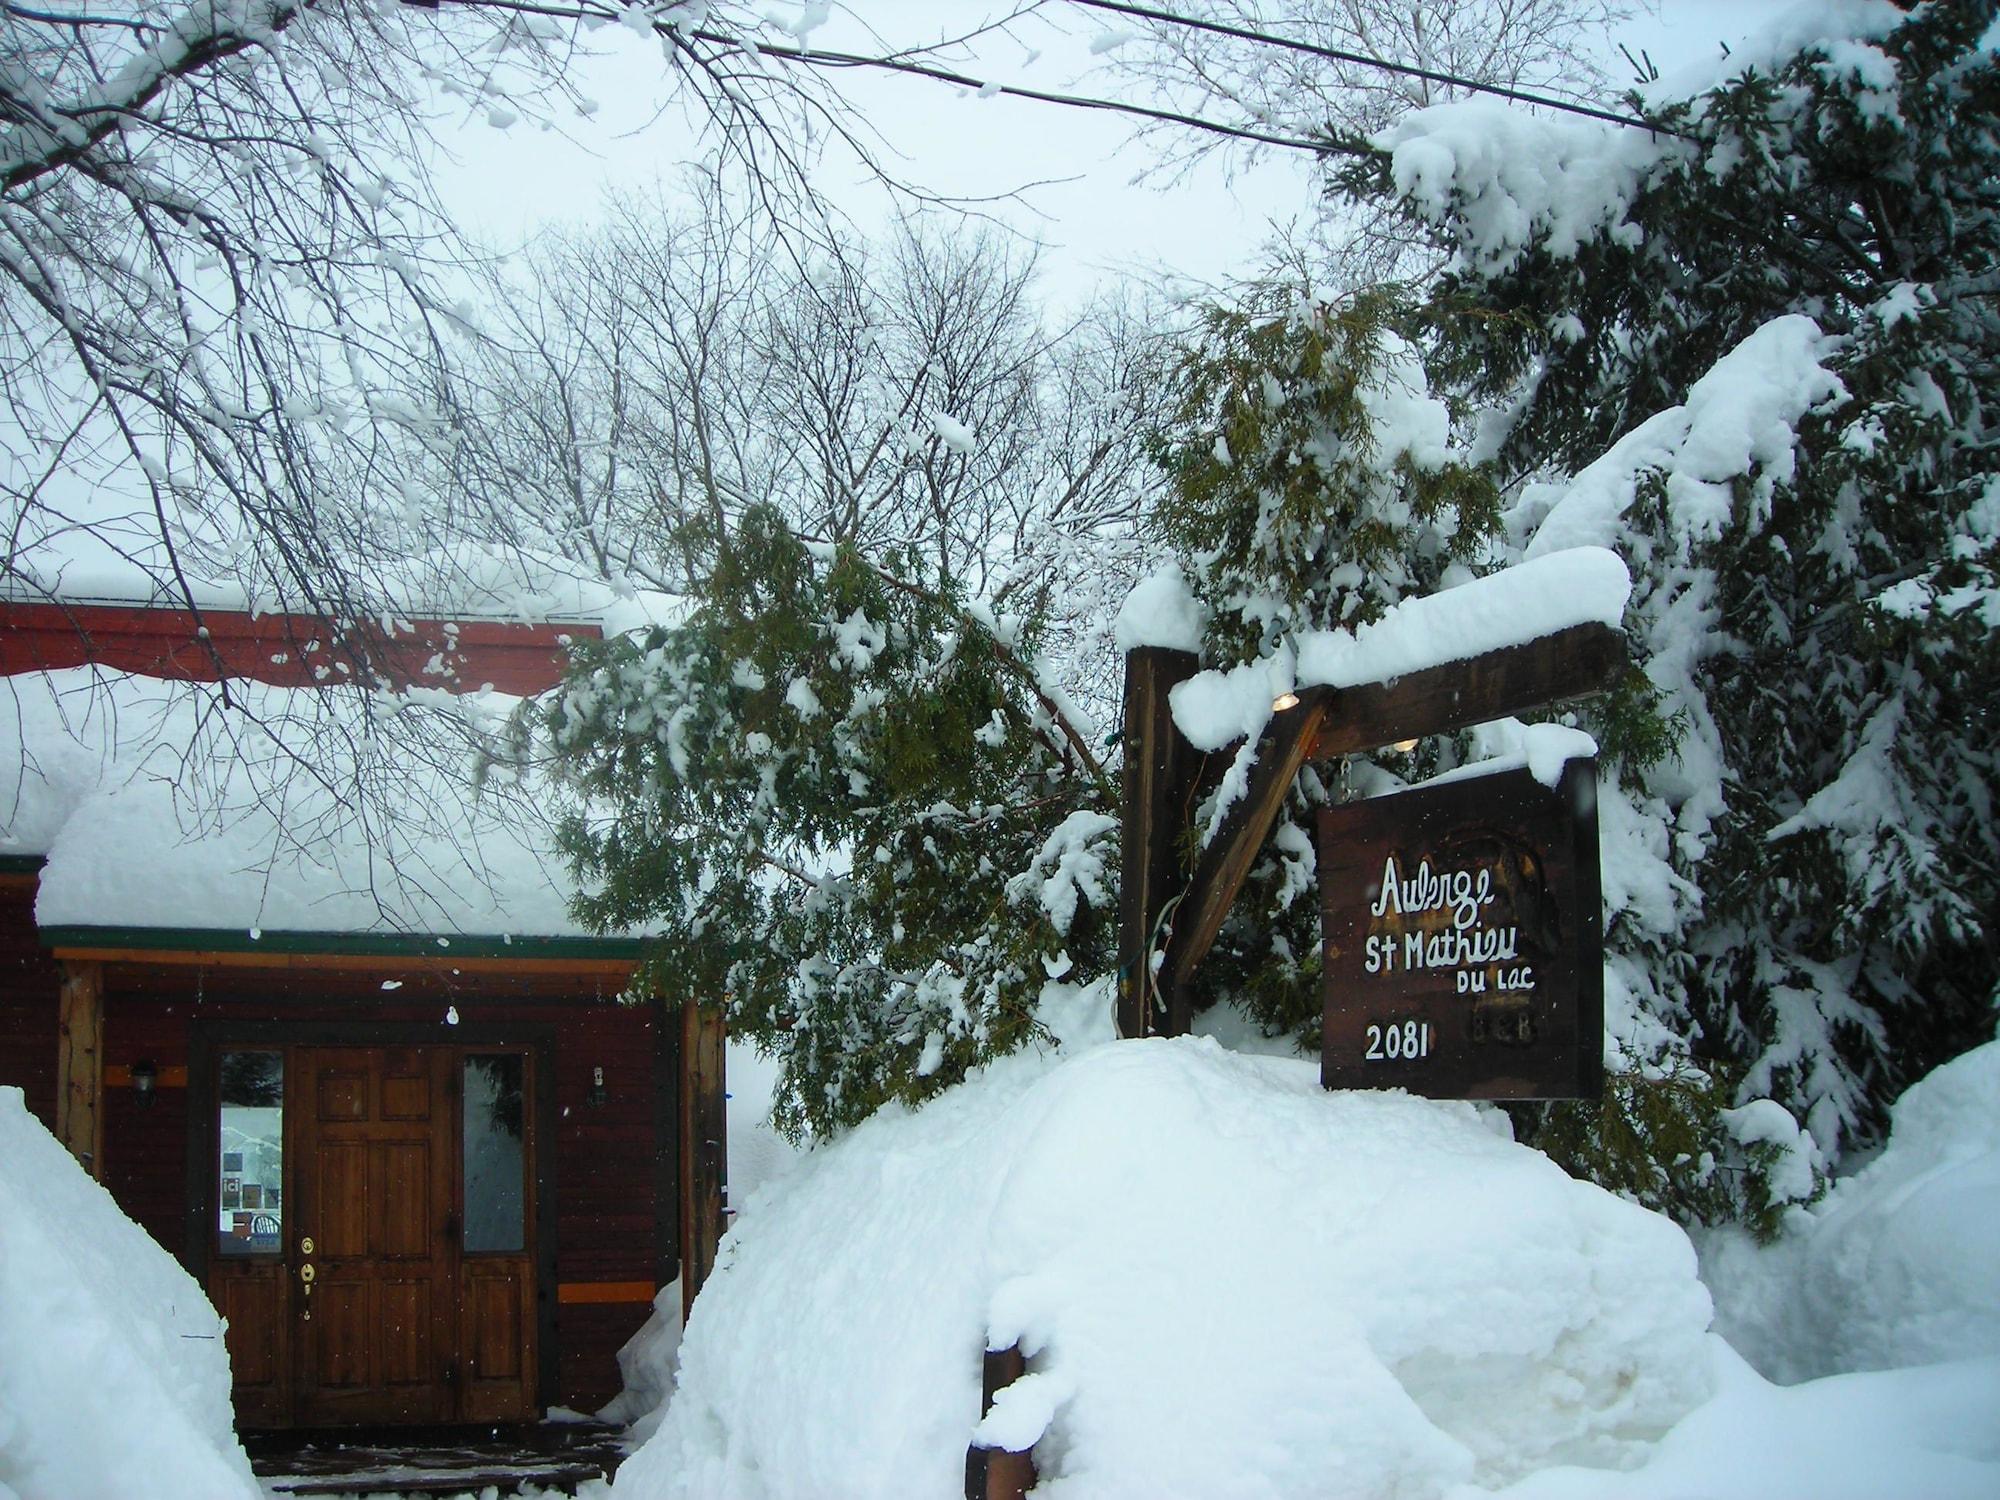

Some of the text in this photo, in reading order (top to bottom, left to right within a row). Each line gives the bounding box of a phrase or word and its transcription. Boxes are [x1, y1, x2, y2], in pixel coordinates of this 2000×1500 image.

[1371, 856, 1496, 930] Auberge
[1364, 922, 1518, 973] St Mathieu
[1365, 1021, 1429, 1060] 2081
